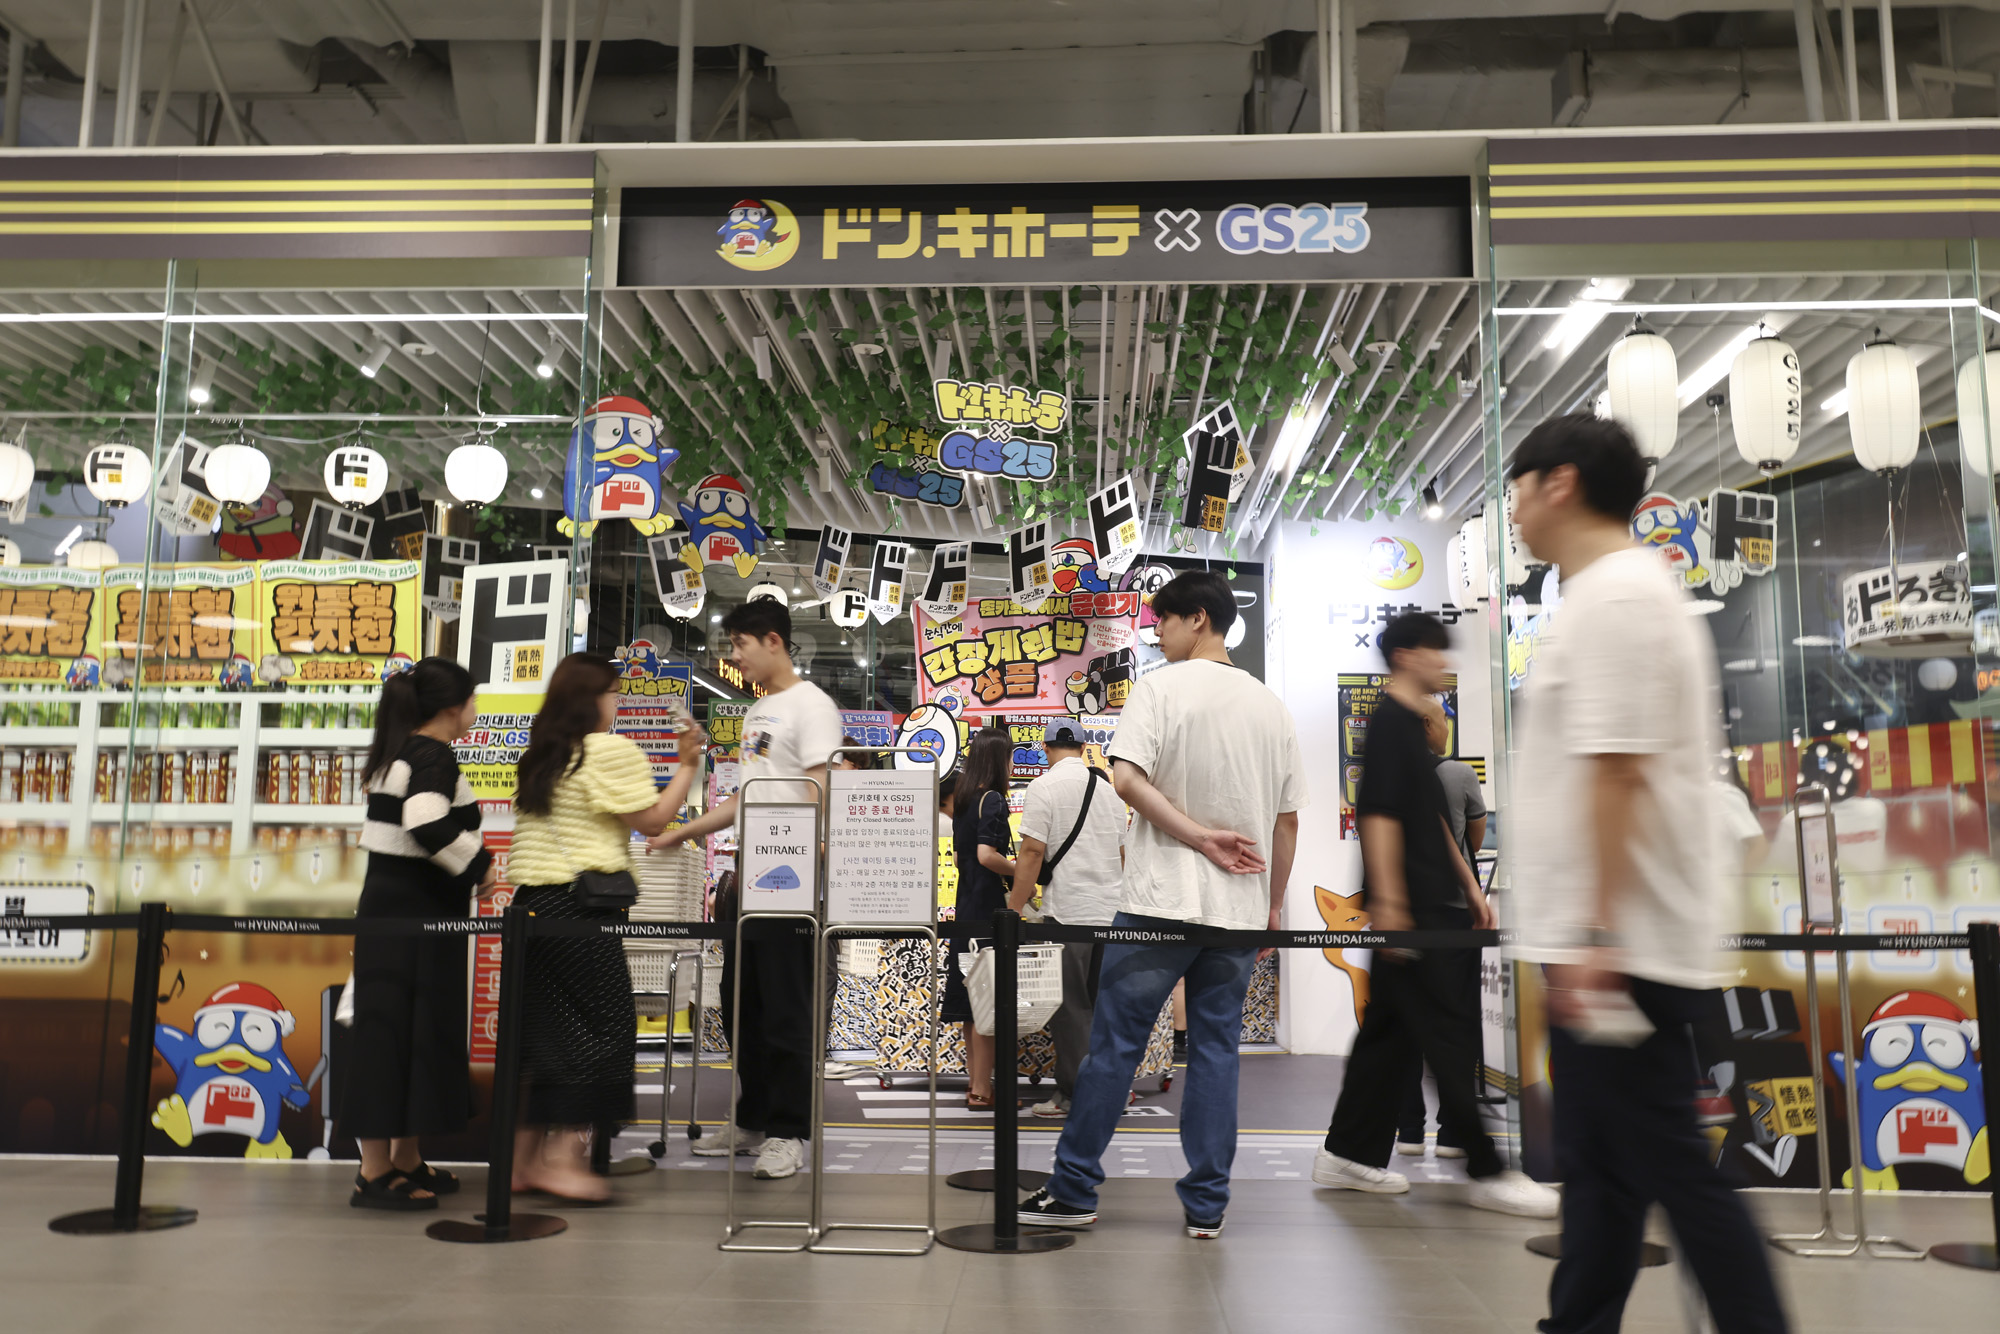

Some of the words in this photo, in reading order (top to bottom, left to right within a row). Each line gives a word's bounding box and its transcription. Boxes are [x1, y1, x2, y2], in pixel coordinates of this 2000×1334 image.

[1216, 203, 1370, 254] GS25
[941, 433, 1055, 480] GS25
[262, 565, 316, 579] JONETZ에서
[388, 563, 418, 579] 감자칩
[517, 648, 541, 663] 情熱
[503, 647, 511, 683] JONETZ
[516, 664, 540, 679] 価格
[491, 714, 516, 727] 대표
[505, 731, 533, 745] GS
[847, 794, 881, 803] [돈키호테
[890, 794, 915, 803] GS25]
[848, 805, 867, 815] 입장
[871, 805, 890, 815] 종료
[894, 805, 914, 815] 안내
[755, 846, 808, 855] ENTRANCE
[0, 918, 29, 929] NDAI
[233, 921, 247, 930] THE
[248, 919, 298, 932] HYUNDAI
[299, 922, 320, 931] SEOUL
[423, 923, 436, 931] THE
[437, 921, 489, 932] HYUNDAI
[615, 924, 666, 936] HYUNDAI
[667, 927, 690, 935] SEOUL
[1093, 931, 1108, 939] THE
[1109, 930, 1162, 942] HYUNDAI
[1163, 933, 1186, 941] SEOUL
[1293, 935, 1307, 943] THE
[1308, 934, 1361, 945] HYUNDAI
[1363, 936, 1386, 944] SEOUL
[1879, 938, 1893, 947] THE
[1895, 936, 1949, 948] HYUNDAI
